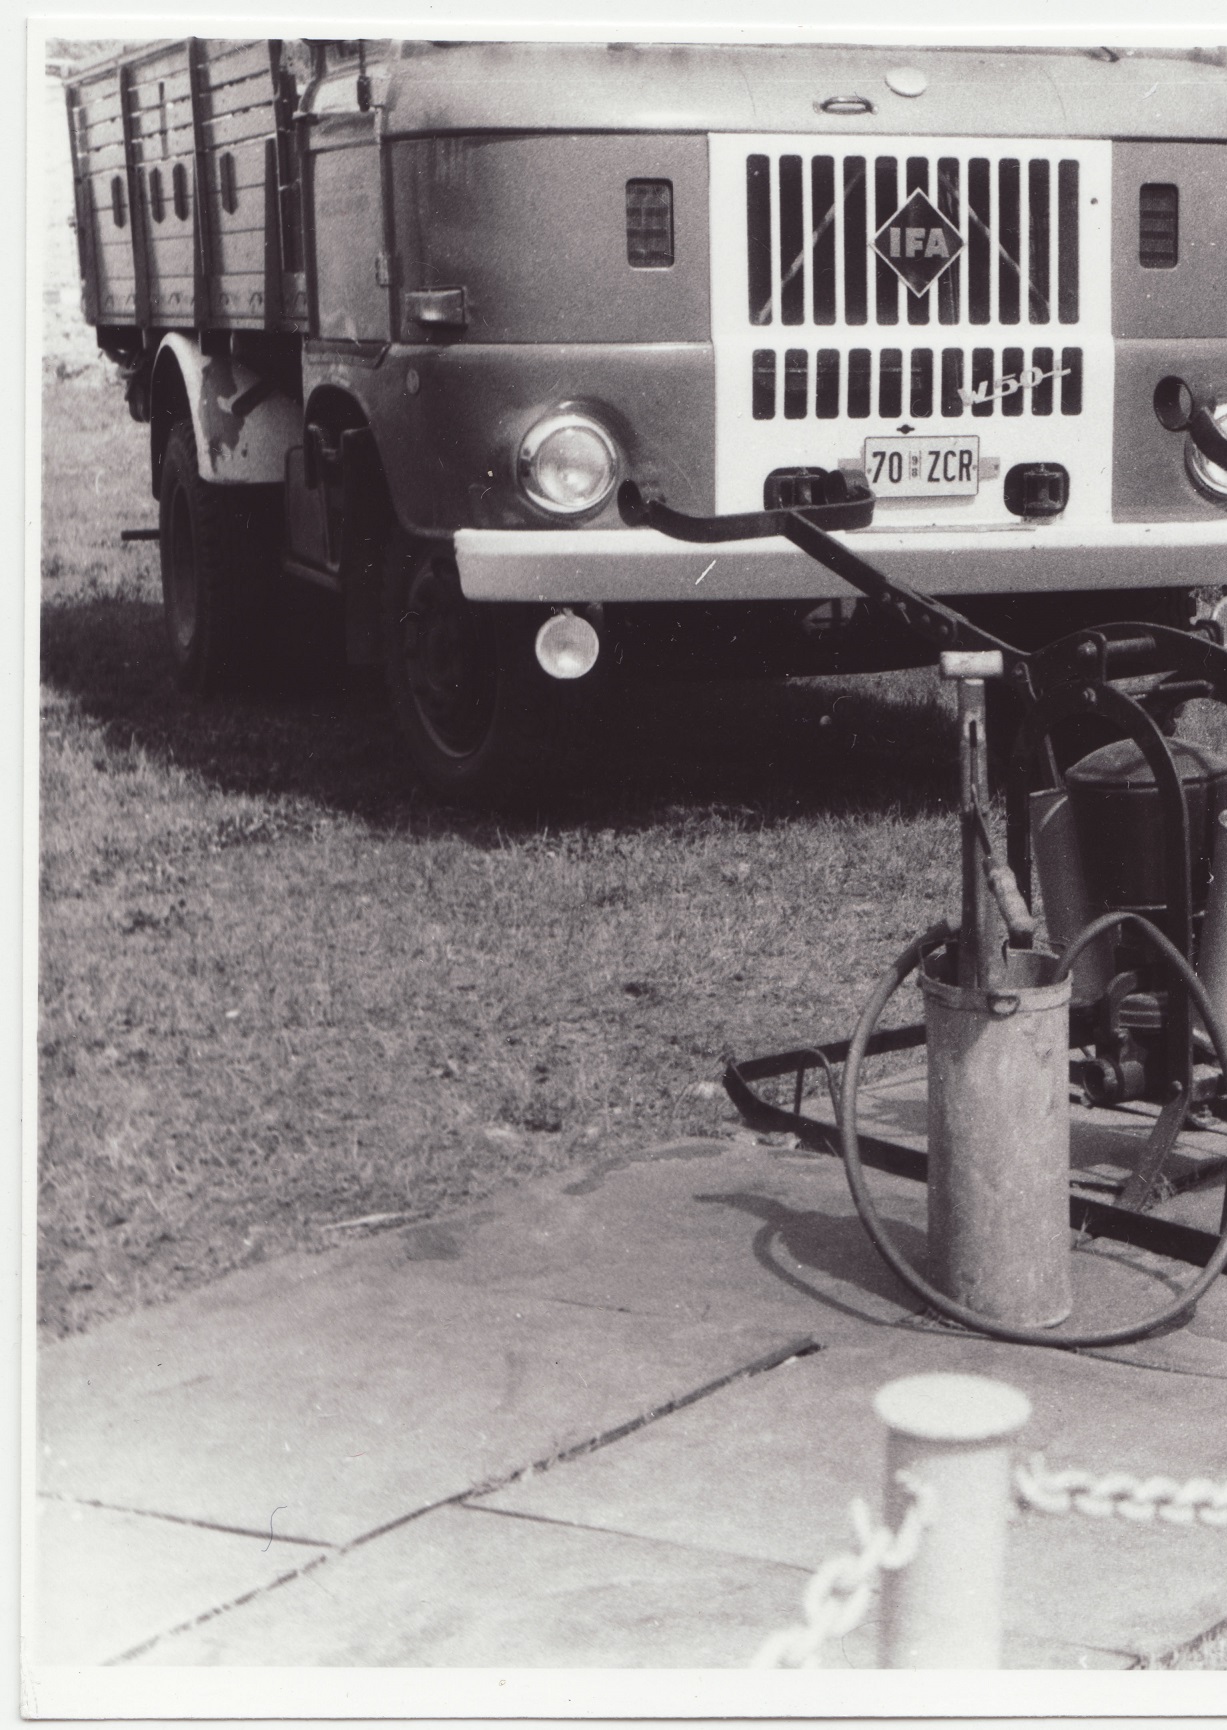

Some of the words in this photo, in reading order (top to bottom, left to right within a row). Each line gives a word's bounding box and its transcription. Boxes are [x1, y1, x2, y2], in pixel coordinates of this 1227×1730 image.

[889, 226, 950, 258] IFA
[872, 449, 903, 484] 70
[926, 448, 973, 483] ZCR
